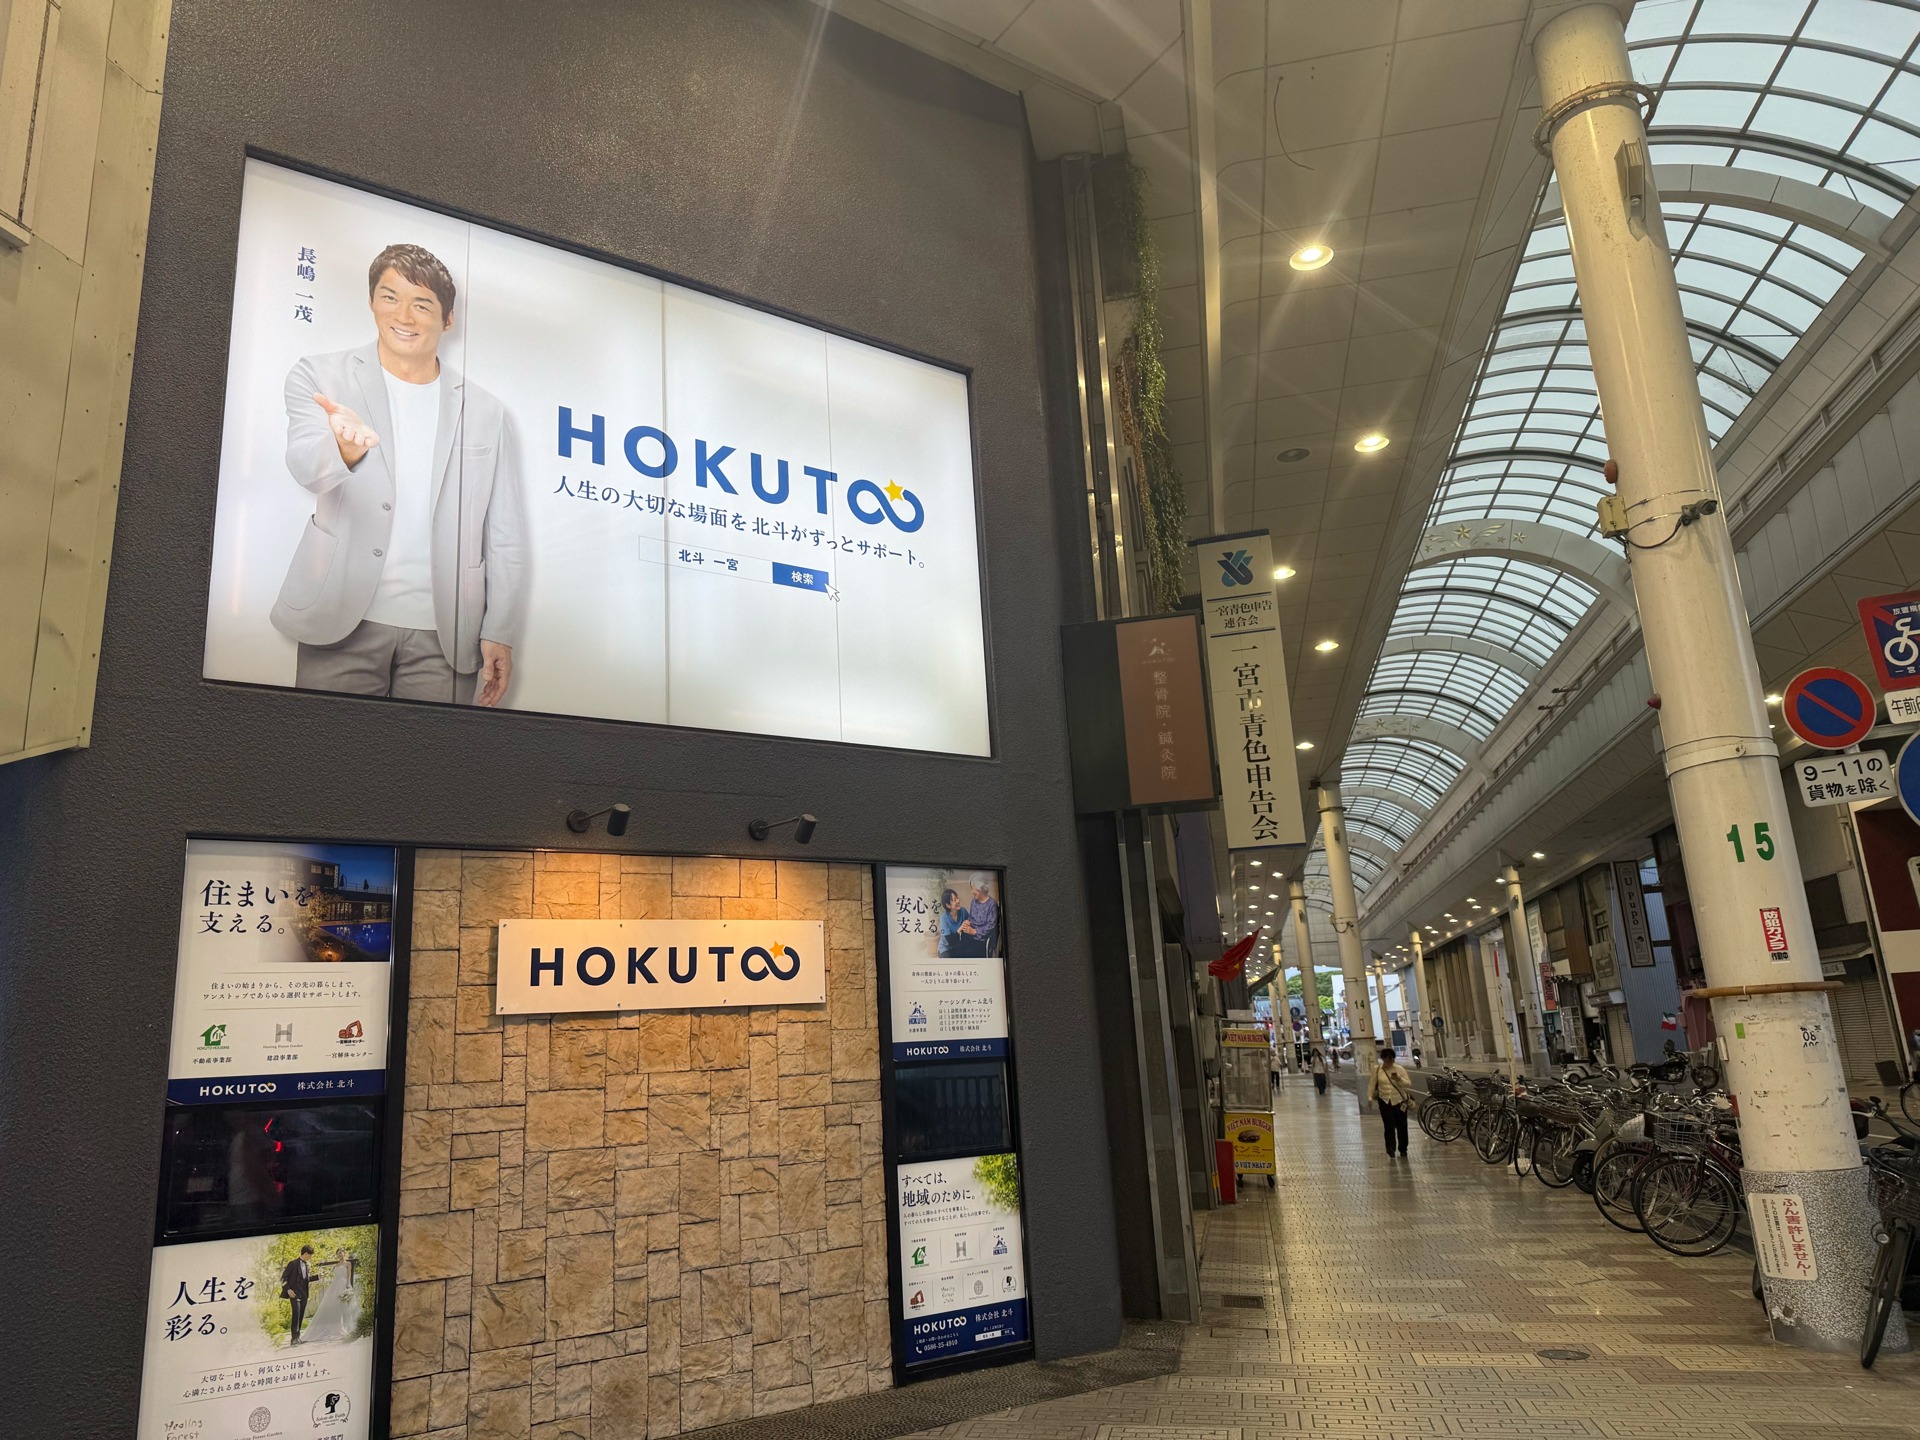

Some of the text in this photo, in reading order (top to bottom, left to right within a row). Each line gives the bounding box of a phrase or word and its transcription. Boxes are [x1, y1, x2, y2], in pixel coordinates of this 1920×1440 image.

[294, 246, 317, 323] 長嶋 一茂
[553, 475, 925, 569] 人生の大切な場面を北斗がずっとサポート。
[678, 548, 814, 586] 北斗 一宮 検索
[1207, 599, 1273, 617] 一宮青色申告
[1224, 614, 1259, 629] 連合会
[1894, 664, 1920, 674] 一宮
[1153, 670, 1177, 781] 整骨院・鍼灸院
[1231, 645, 1279, 841] 一宮市青色申告会
[1806, 777, 1890, 802] 貨物を除く
[1726, 821, 1775, 863] 15
[199, 879, 314, 908] 住まいを
[896, 894, 943, 915] 安心を
[197, 910, 286, 935] 支える。
[897, 916, 946, 934] 支える。
[1762, 910, 1785, 950] 防犯カメラ
[203, 991, 361, 1000] ワンストップであらゆる選択をサポートします。
[211, 981, 355, 990] 住まいの始まりから、その先の暮らしまで。
[192, 1056, 233, 1065] 不動産事業部
[266, 1054, 299, 1062] 建設事業部
[297, 1080, 334, 1091] 株式会社
[336, 1078, 355, 1089] 北斗
[901, 1171, 948, 1188] すべては、
[901, 1188, 976, 1208] 地域のために。
[166, 1276, 255, 1310] 人生を
[163, 1313, 228, 1342] 彩る。
[975, 1311, 1000, 1323] 株式会社
[182, 1368, 331, 1399] 心満たされる豊かな時間をお届けします。
[201, 1359, 317, 1384] 大切な一日も、何気ない日常も。
